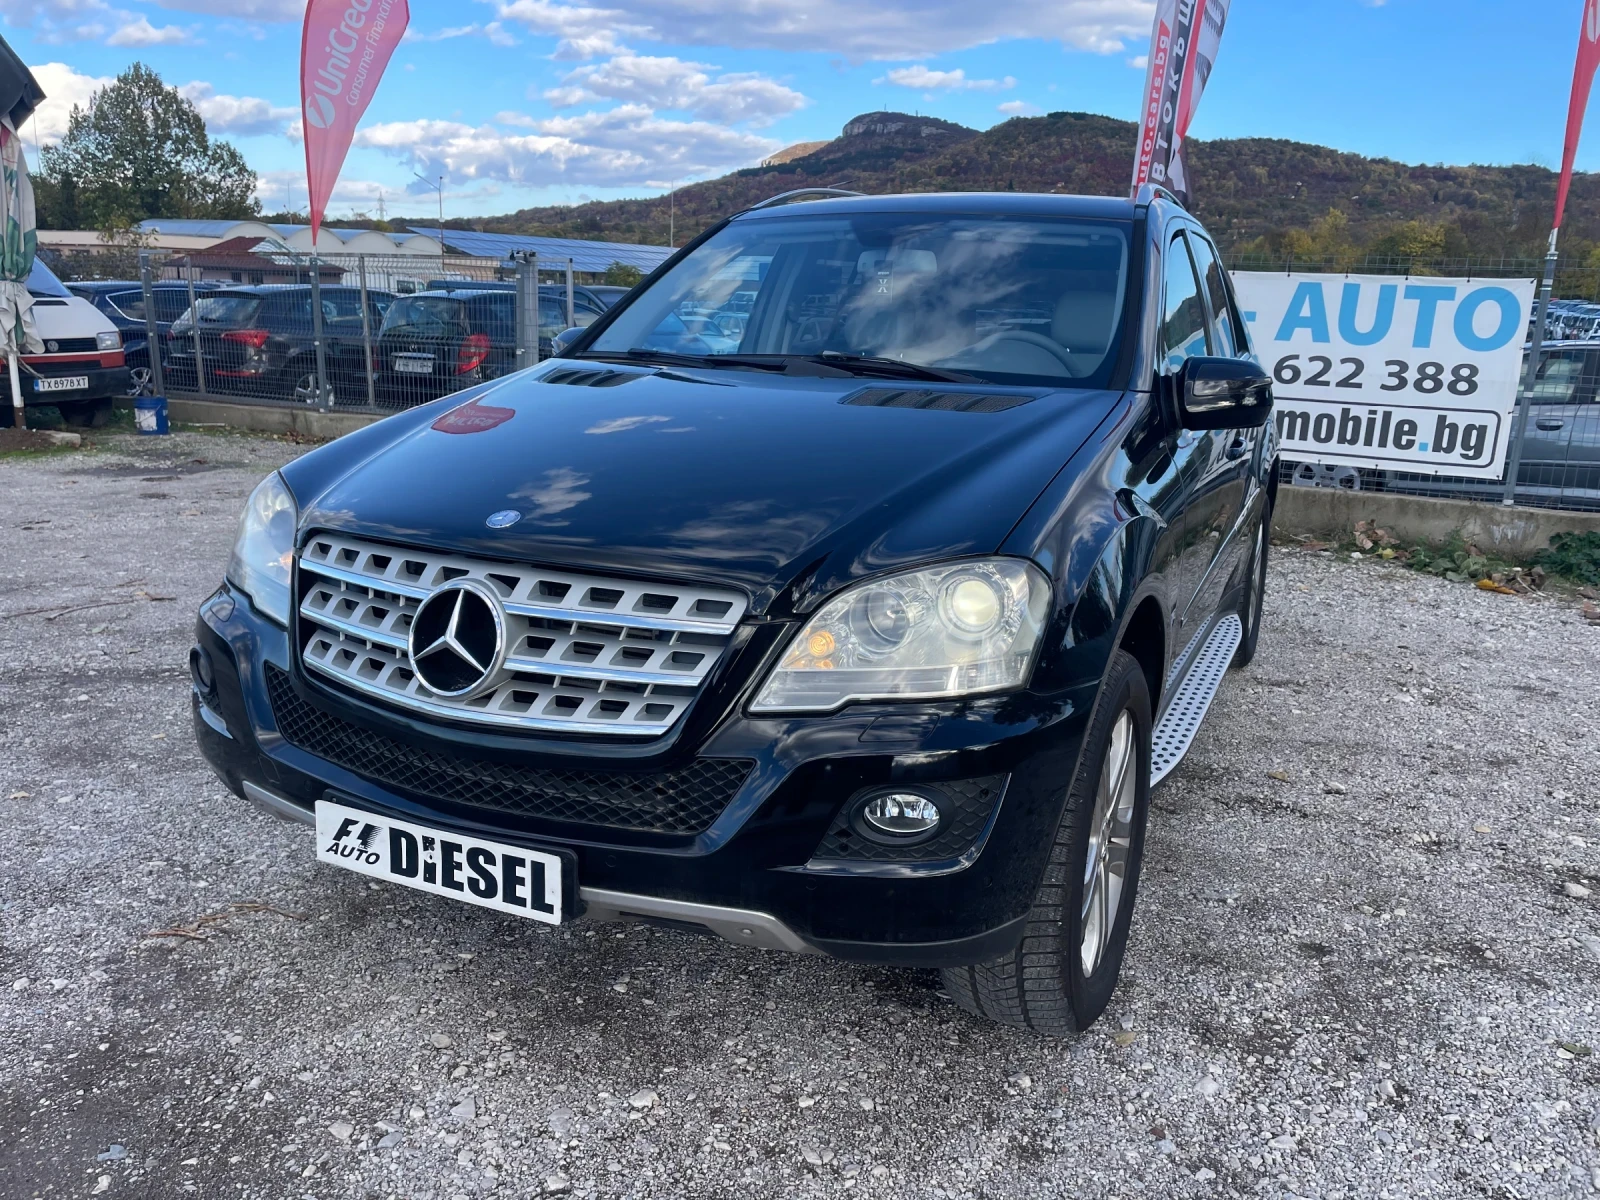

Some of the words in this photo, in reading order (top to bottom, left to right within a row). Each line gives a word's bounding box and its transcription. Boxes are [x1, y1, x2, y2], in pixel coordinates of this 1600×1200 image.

[346, 45, 375, 106] Consumer
[366, 0, 398, 46] Financin
[1139, 35, 1170, 187] uto.cars.bg
[1274, 281, 1522, 352] AUTO
[40, 380, 53, 390] TX
[53, 378, 75, 389] 8978
[75, 377, 87, 388] XT
[1273, 354, 1366, 389] 622
[1380, 359, 1480, 396] 388
[1275, 407, 1488, 461] mobile.bg
[325, 841, 381, 865] AUTO
